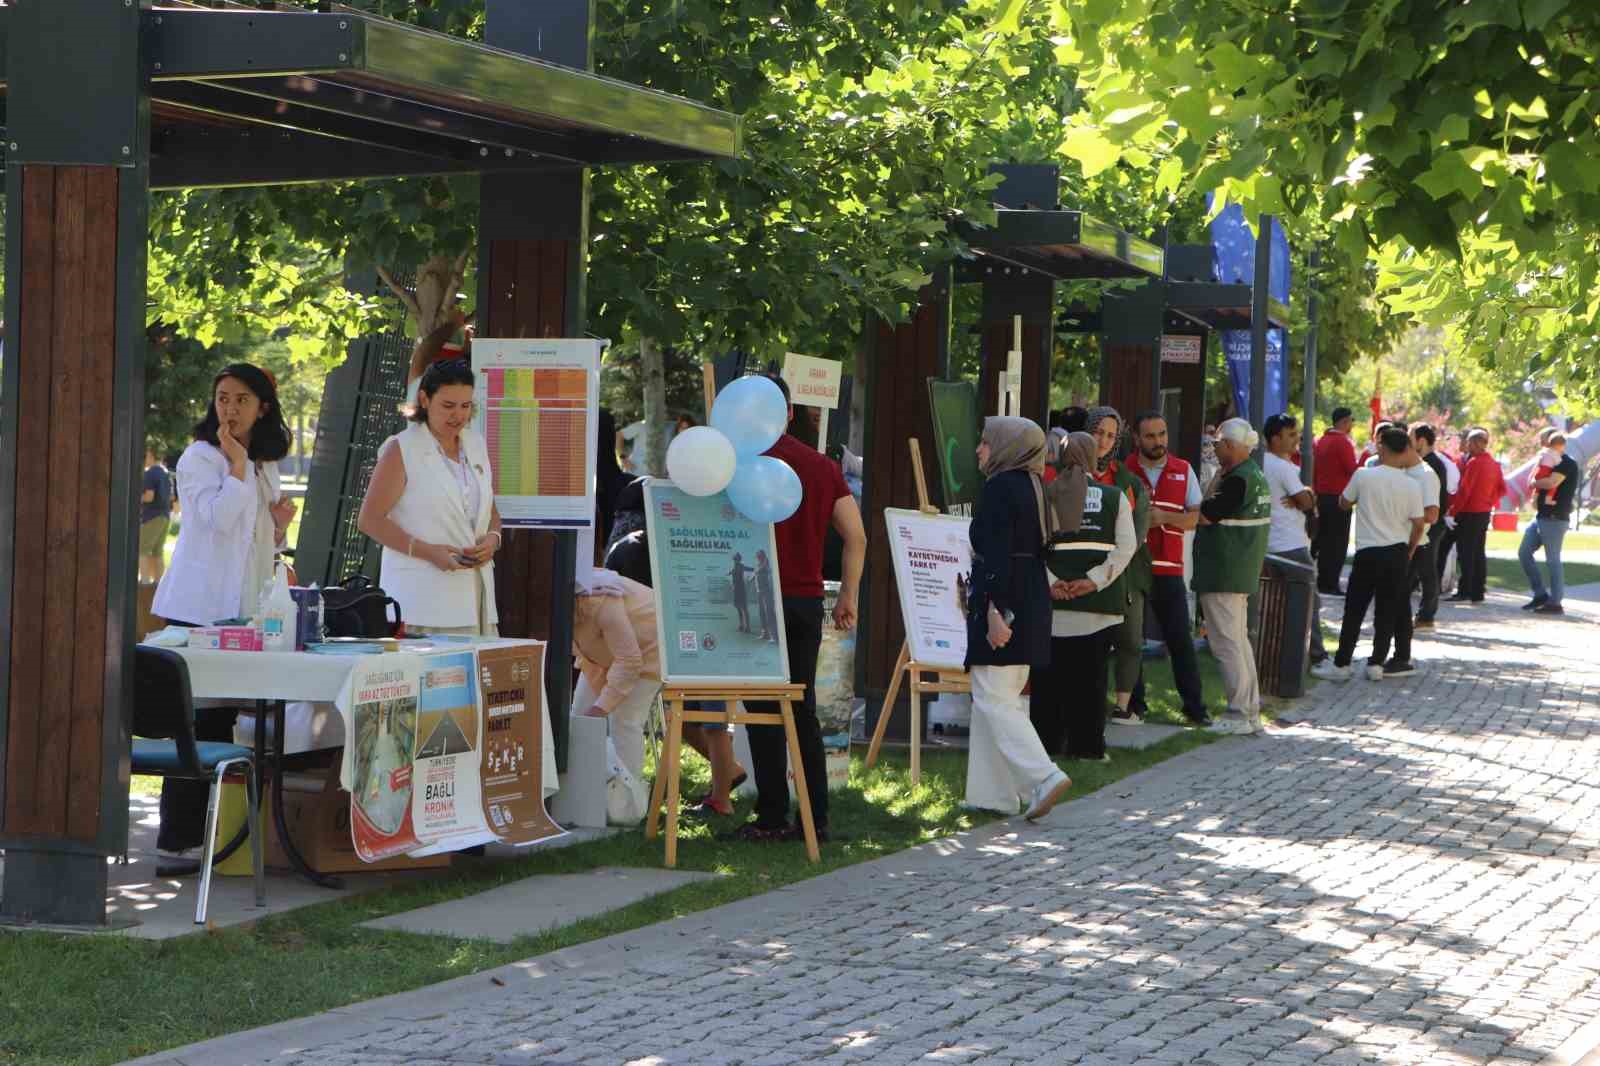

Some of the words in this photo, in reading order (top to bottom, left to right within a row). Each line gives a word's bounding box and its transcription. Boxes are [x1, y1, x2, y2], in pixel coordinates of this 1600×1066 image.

[713, 540, 732, 550] KAL
[488, 745, 524, 769] ŞEKER
[426, 781, 455, 800] BAĞLI
